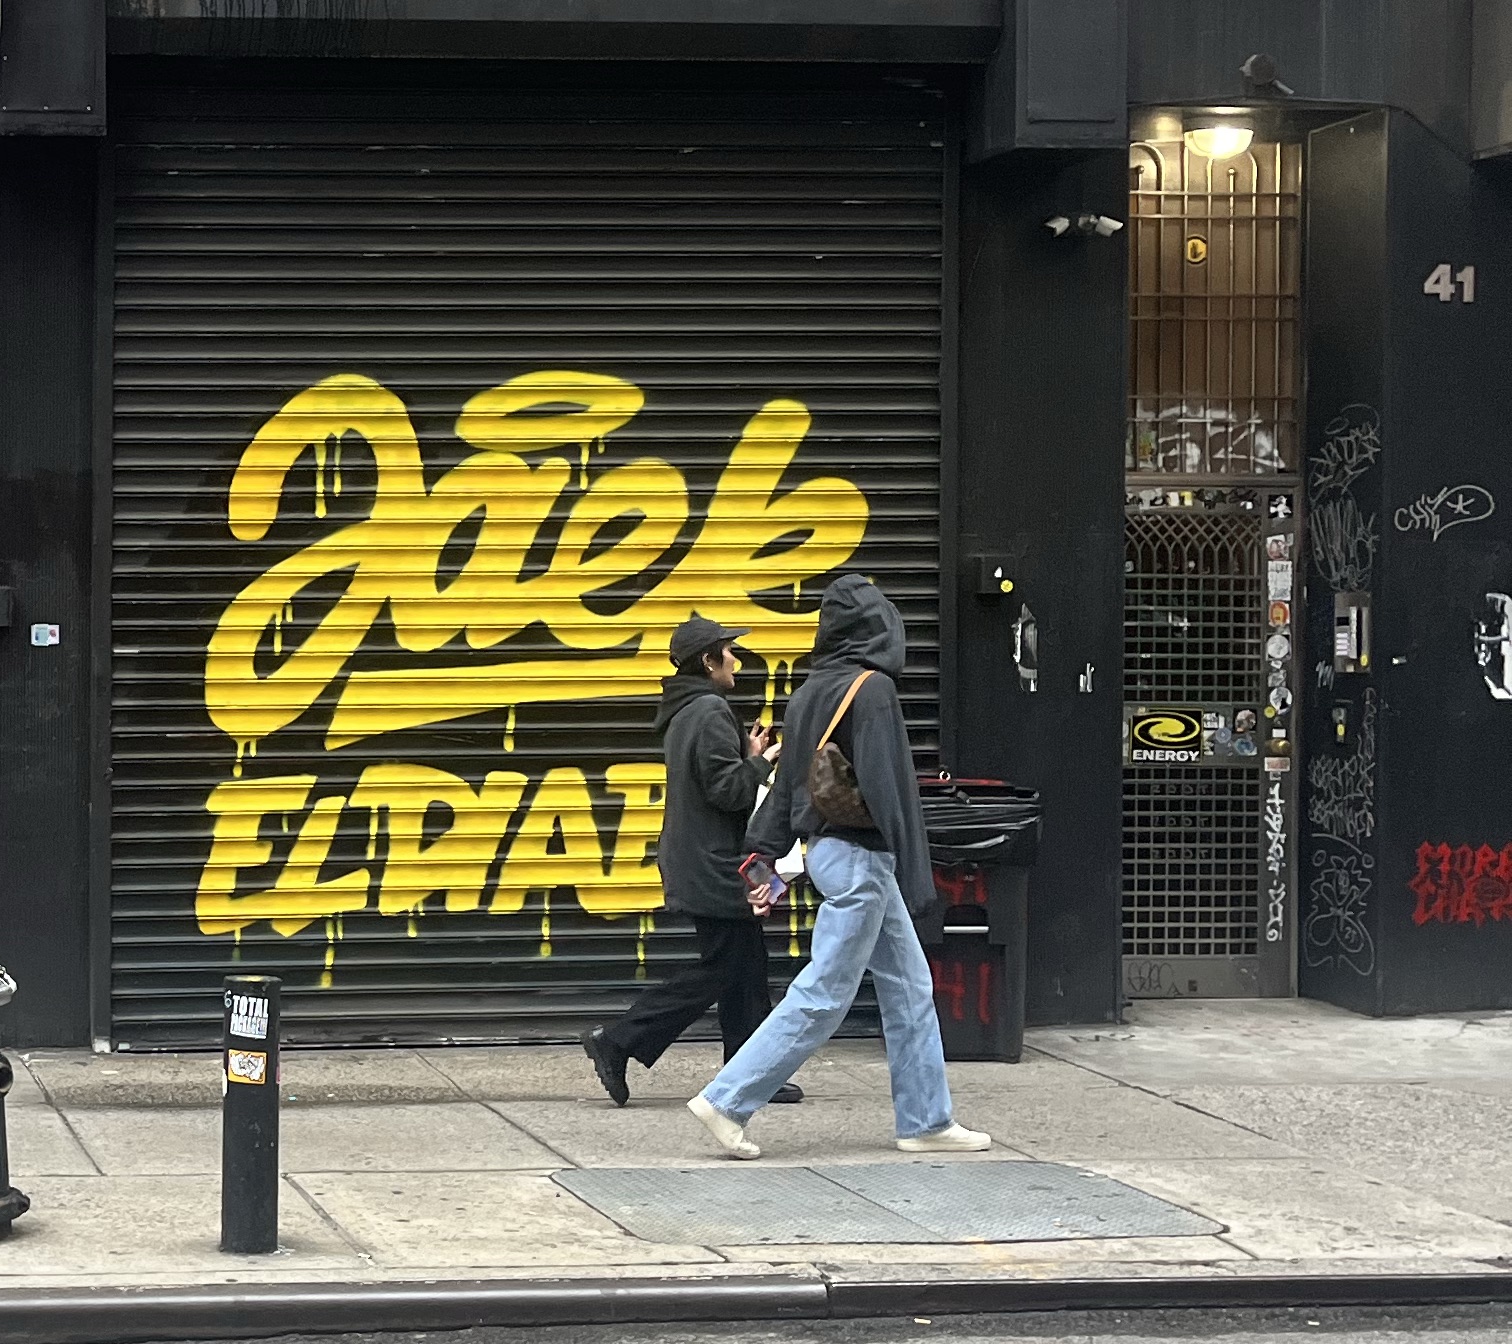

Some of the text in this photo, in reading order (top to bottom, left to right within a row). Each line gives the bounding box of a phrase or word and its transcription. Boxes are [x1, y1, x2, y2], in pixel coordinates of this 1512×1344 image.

[1423, 263, 1475, 303] 41
[1132, 749, 1200, 762] ENERGY
[232, 994, 269, 1018] TOTAL
